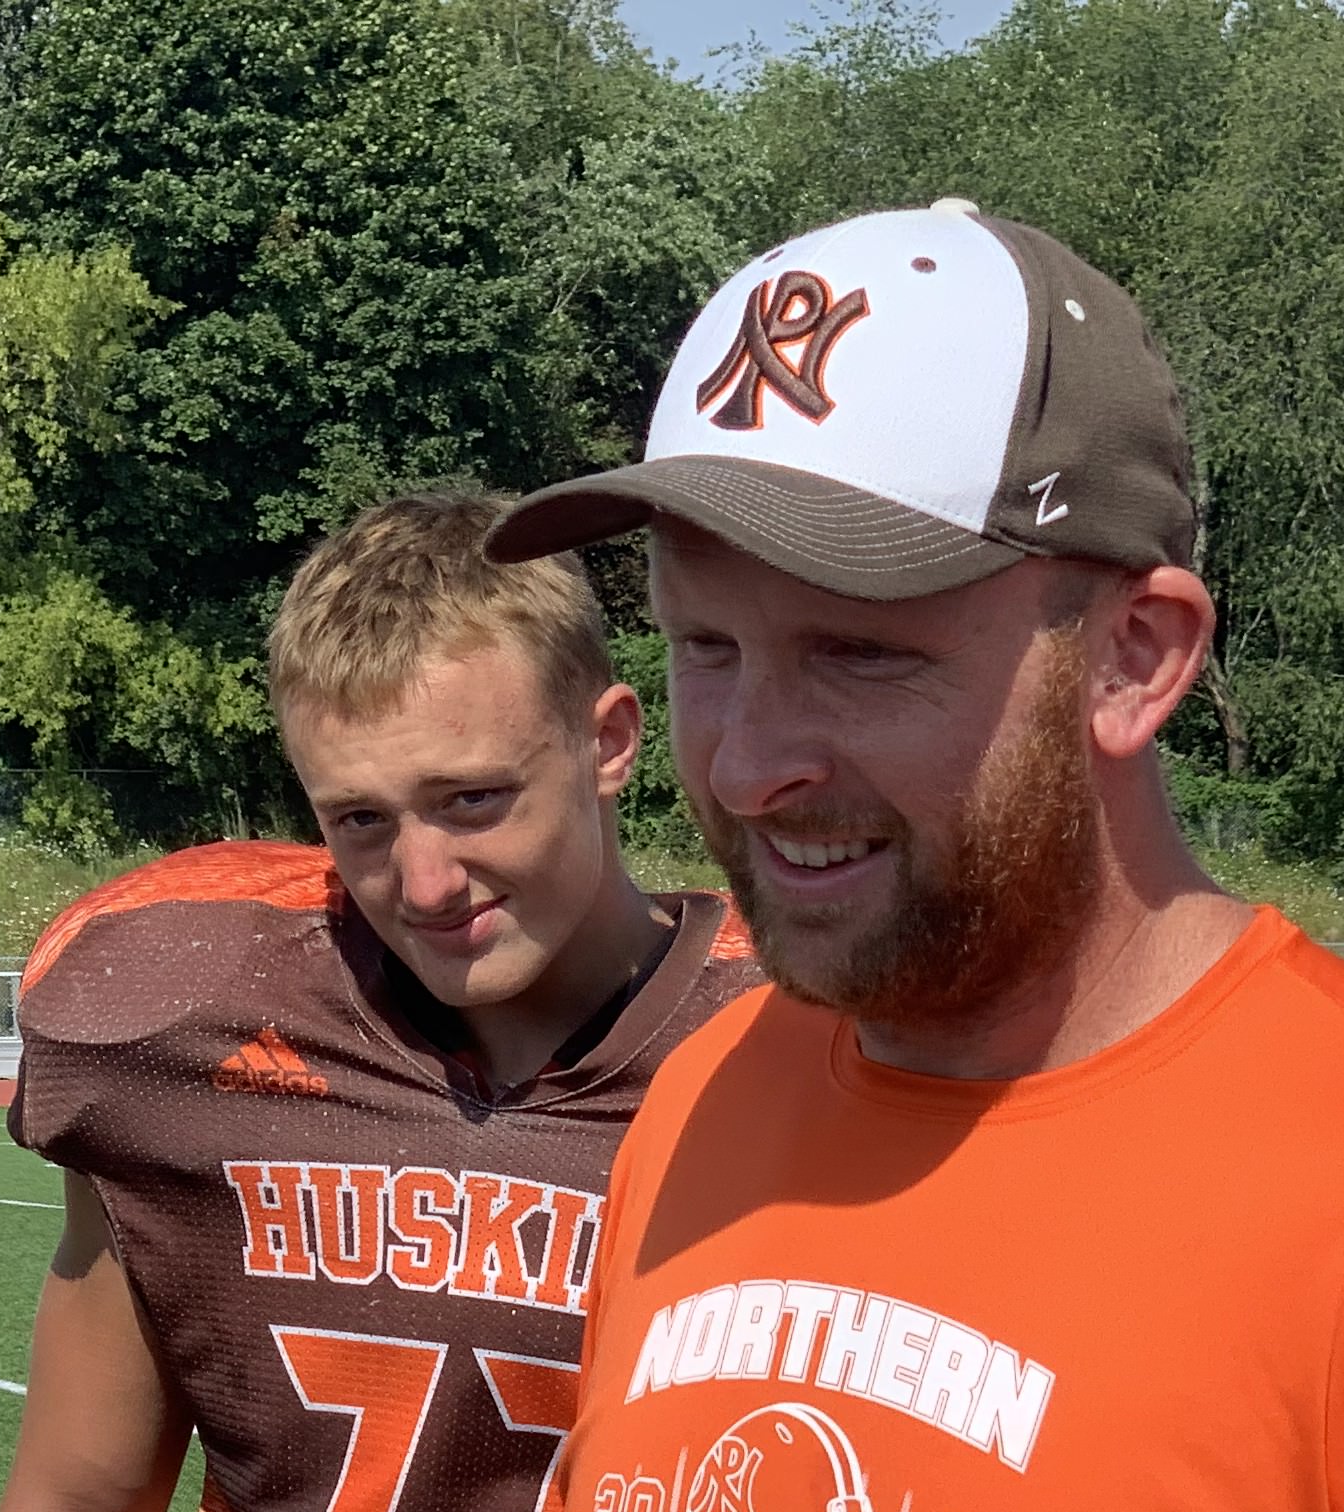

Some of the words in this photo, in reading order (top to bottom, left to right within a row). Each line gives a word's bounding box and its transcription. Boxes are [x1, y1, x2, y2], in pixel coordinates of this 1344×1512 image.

[1027, 471, 1069, 526] Z
[222, 1160, 606, 1316] HUSKI
[624, 1279, 1056, 1475] NORTHERN
